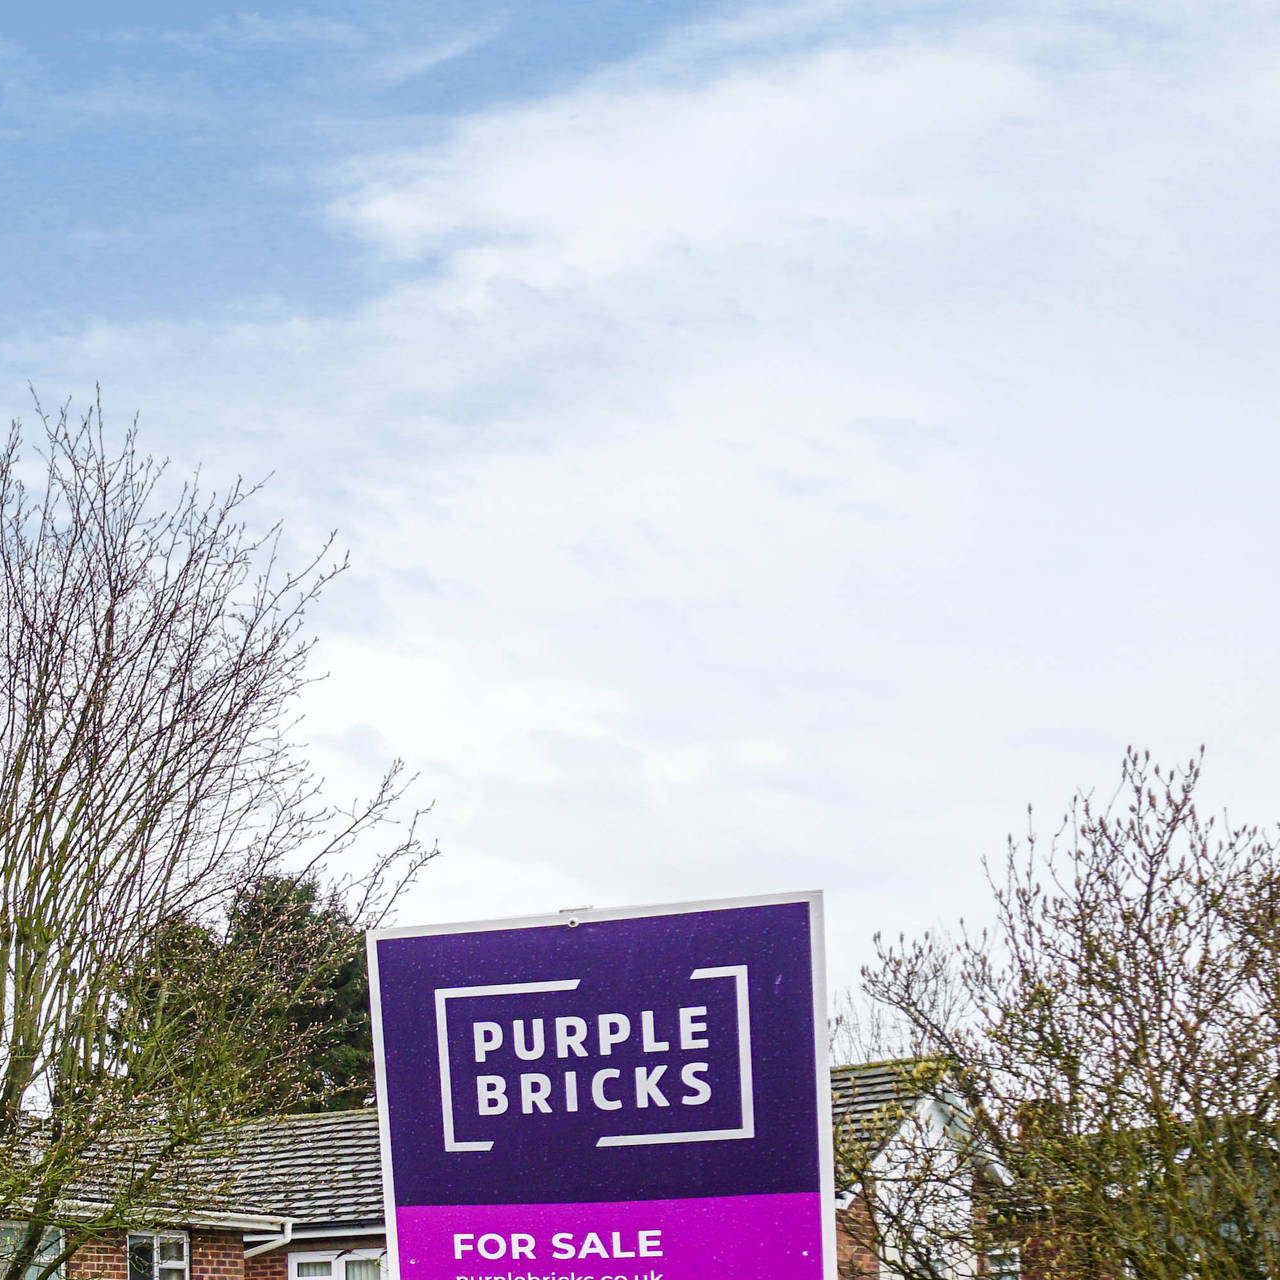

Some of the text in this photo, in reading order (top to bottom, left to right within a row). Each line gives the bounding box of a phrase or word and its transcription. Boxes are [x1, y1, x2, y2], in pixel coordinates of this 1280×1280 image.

[472, 1006, 709, 1063] PURPLE
[476, 1063, 712, 1116] BRICKS
[453, 1230, 664, 1260] FOR SALE
